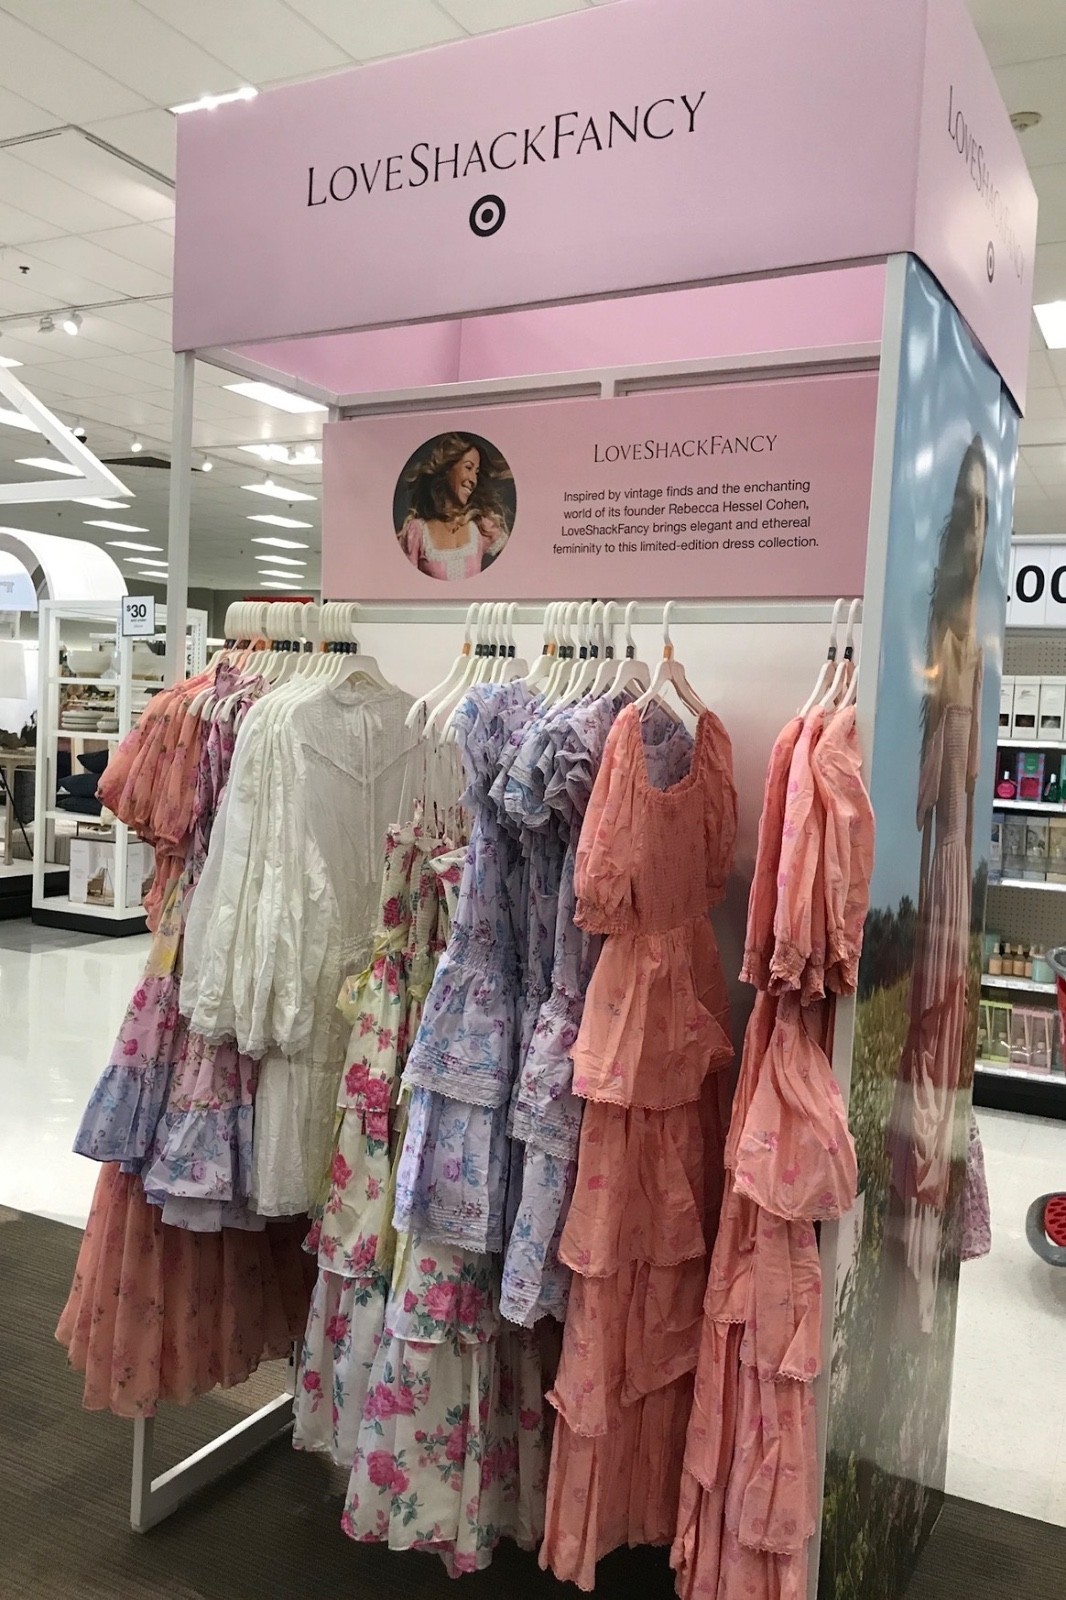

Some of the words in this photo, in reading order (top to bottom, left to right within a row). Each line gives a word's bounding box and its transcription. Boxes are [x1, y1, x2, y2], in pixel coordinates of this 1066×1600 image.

[564, 490, 605, 503] Inspired
[608, 488, 621, 501] by
[624, 487, 663, 501] vintage
[667, 485, 694, 497] finds
[696, 484, 719, 495] and
[721, 483, 740, 494] the
[743, 479, 810, 493] enchanting
[563, 507, 592, 519] world
[595, 506, 605, 518] of
[608, 506, 621, 517] its
[623, 505, 665, 516] founder
[668, 503, 719, 514] Rebecca
[722, 499, 762, 512] Hessel
[766, 499, 809, 511] Cohen,
[561, 523, 649, 536] LoveShackFancy
[652, 521, 687, 535] brings
[689, 520, 733, 533] elegant
[735, 519, 758, 530] and
[761, 516, 810, 528] ethereal
[553, 543, 601, 555] femininity
[604, 542, 615, 553] to
[618, 541, 637, 552] this
[640, 538, 719, 552] limited-edition
[722, 538, 755, 549] dress
[758, 536, 819, 548] collection.
[126, 604, 147, 618] $30
